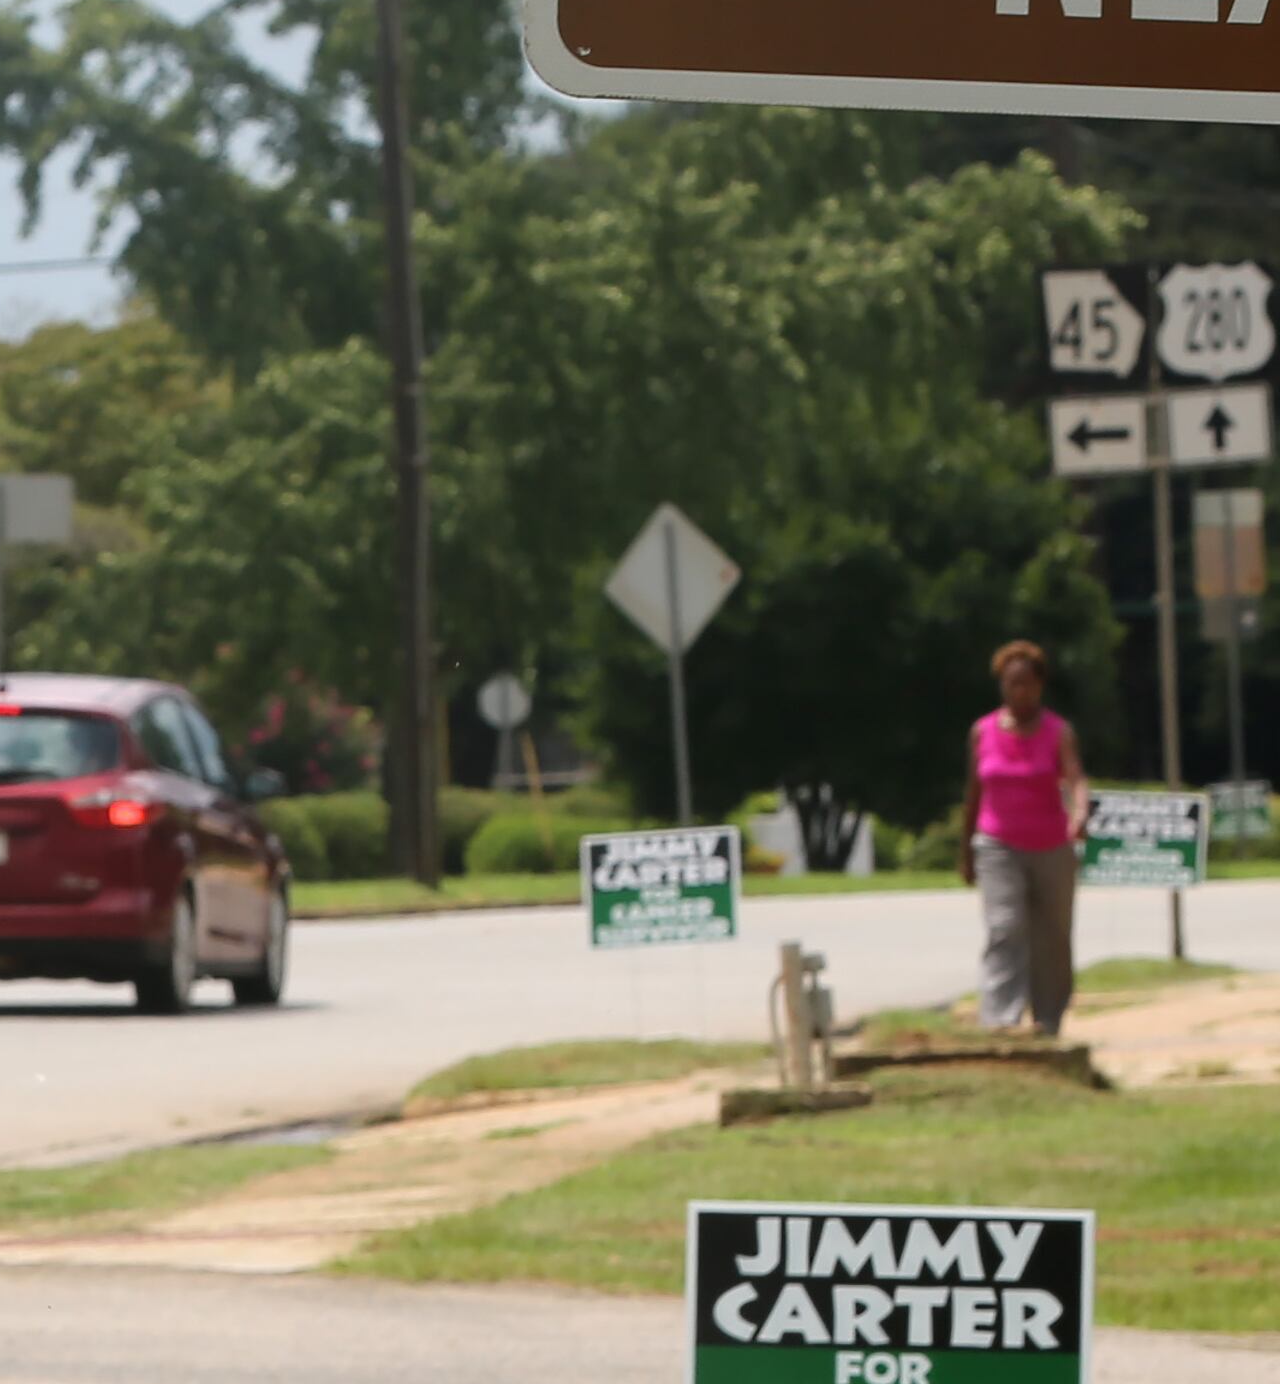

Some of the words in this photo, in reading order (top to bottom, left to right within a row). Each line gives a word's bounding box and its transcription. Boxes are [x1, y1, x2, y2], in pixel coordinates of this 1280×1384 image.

[1053, 297, 1117, 360] 45
[1183, 289, 1253, 354] 280
[737, 1217, 1042, 1280] JIMMY
[714, 1284, 1062, 1347] CARTER
